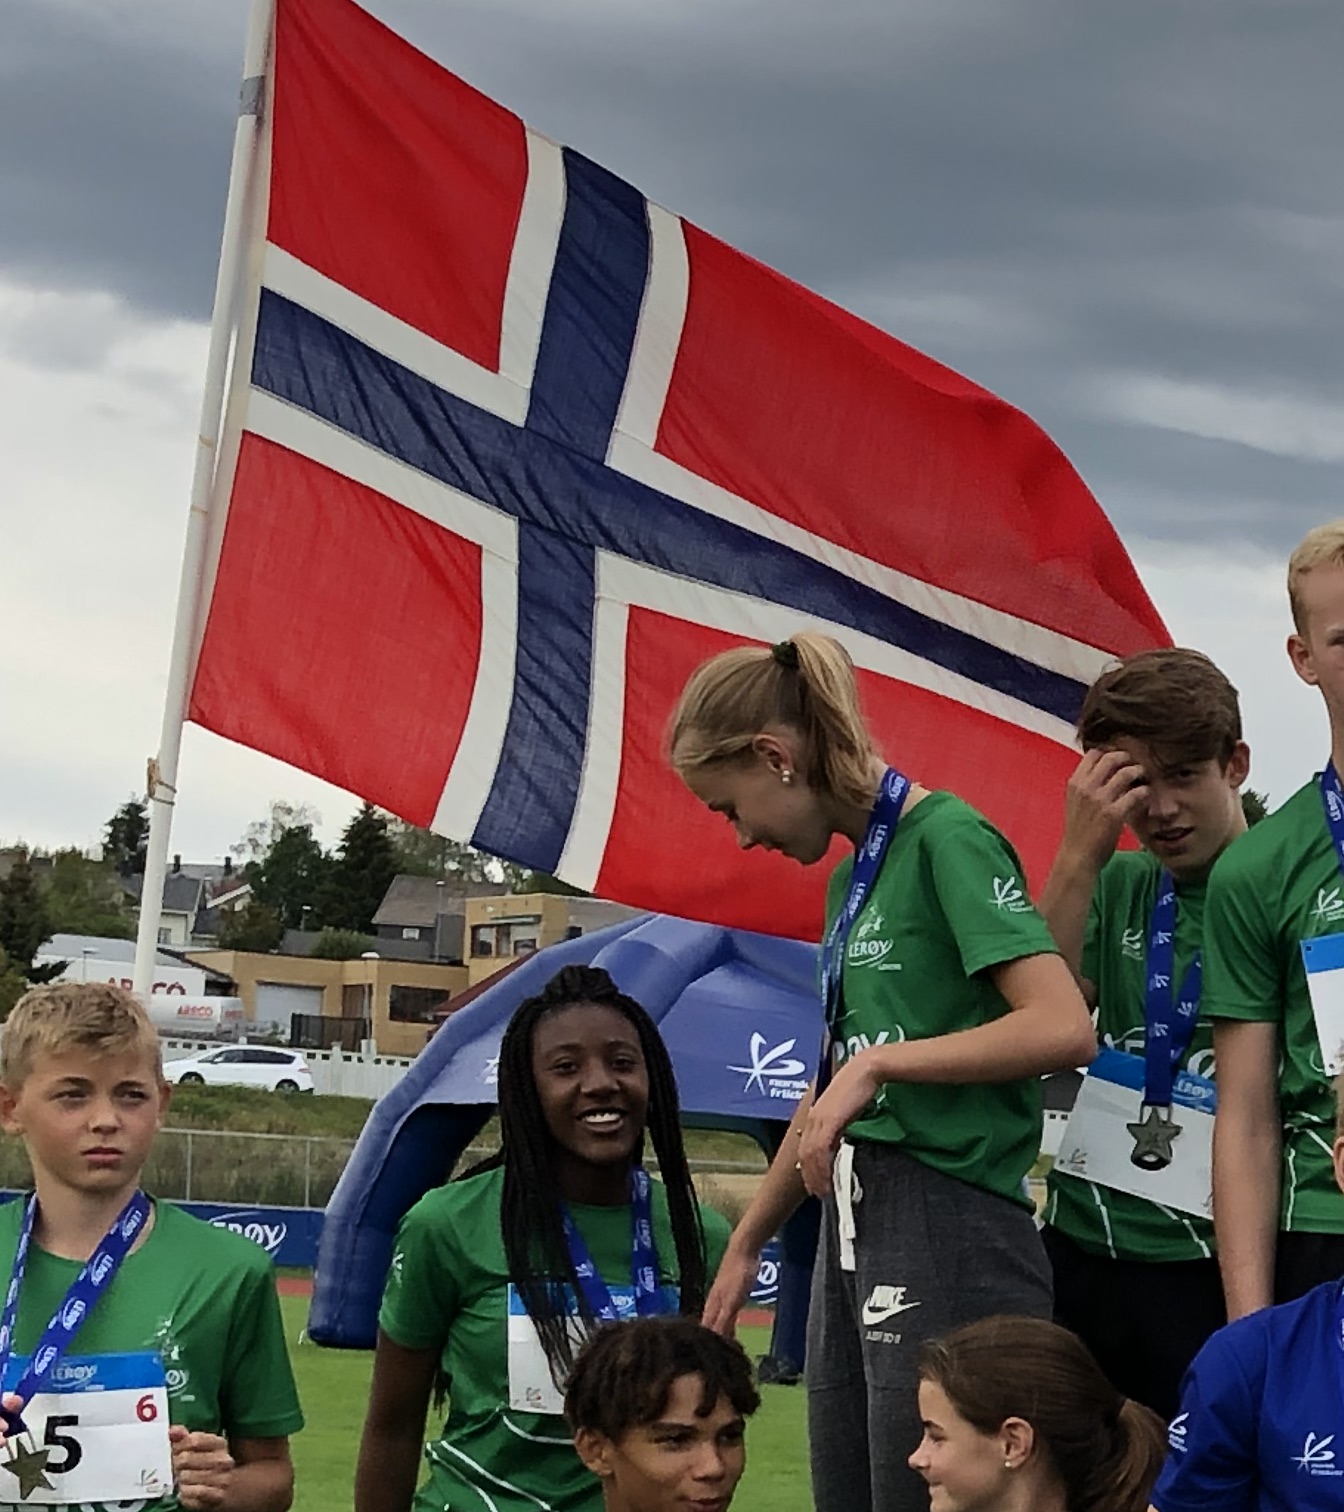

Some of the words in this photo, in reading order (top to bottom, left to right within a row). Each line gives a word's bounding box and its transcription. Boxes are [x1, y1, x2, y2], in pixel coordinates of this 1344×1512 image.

[848, 940, 888, 958] LERØY
[136, 1394, 157, 1422] 6
[46, 1415, 82, 1474] 5
